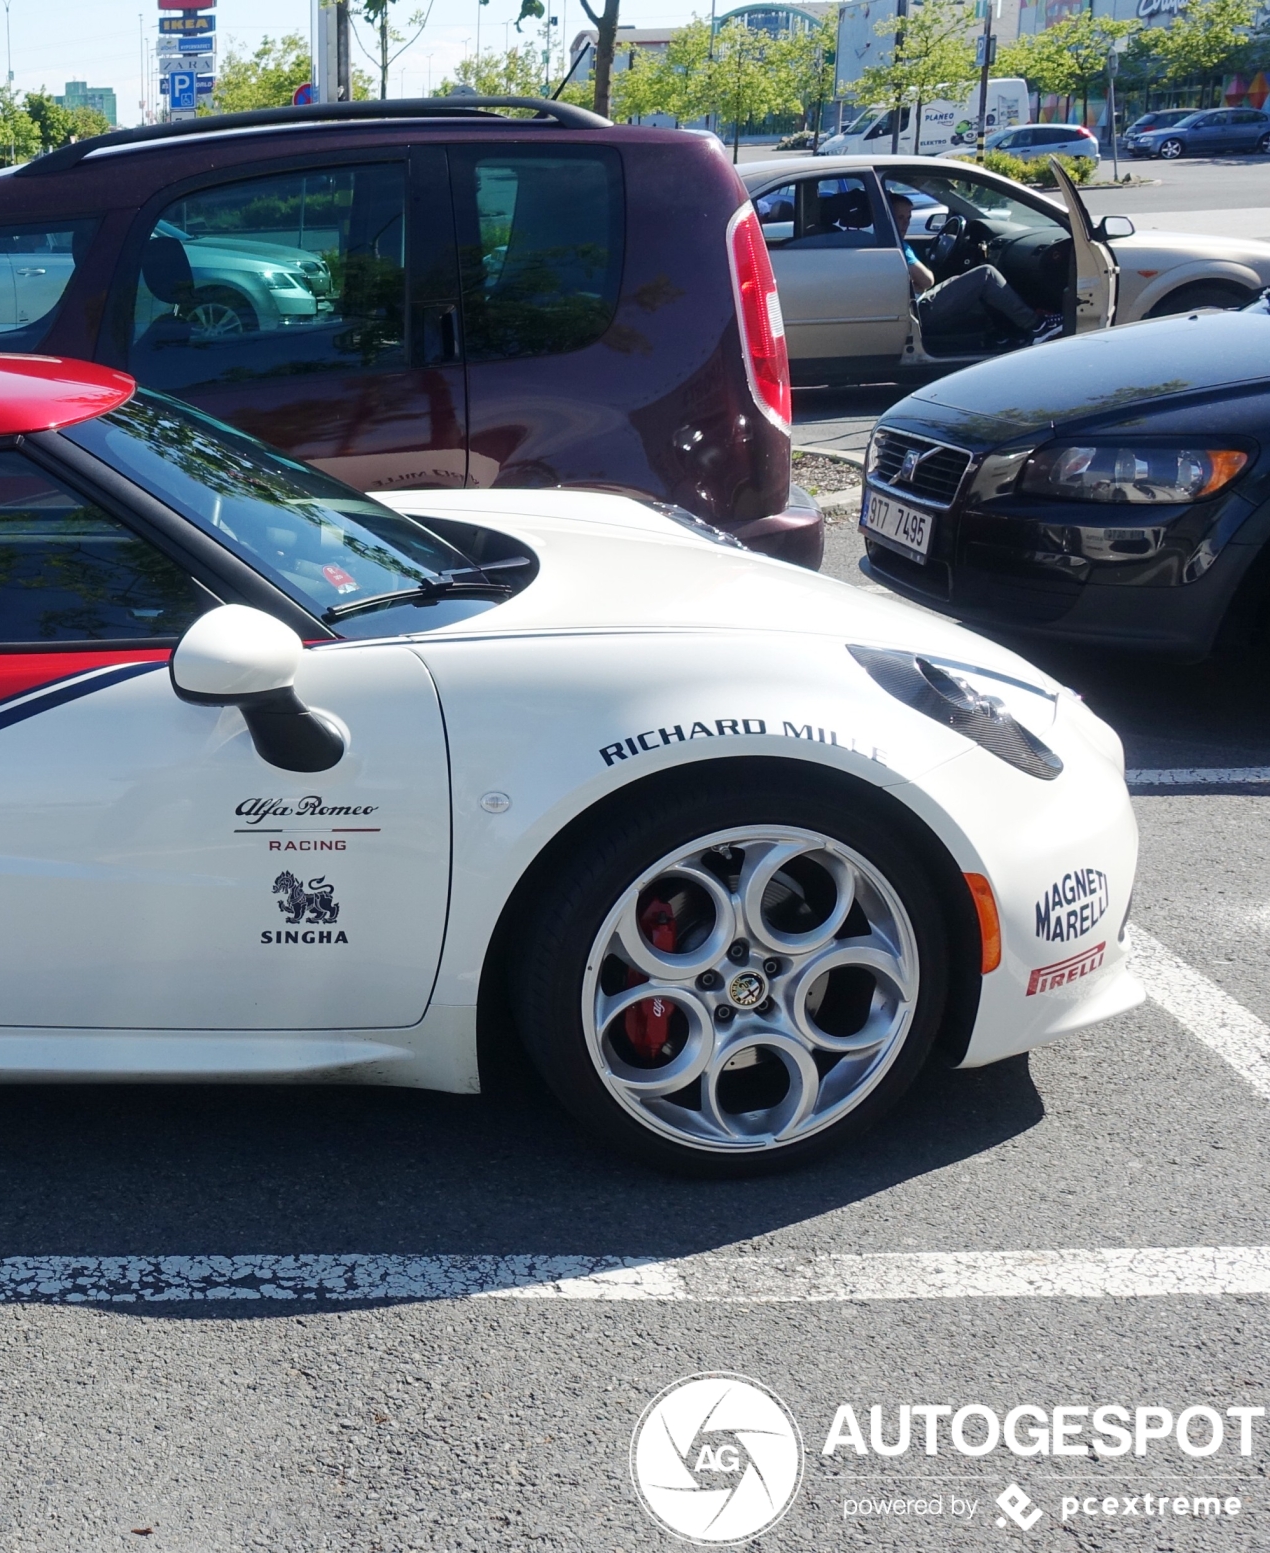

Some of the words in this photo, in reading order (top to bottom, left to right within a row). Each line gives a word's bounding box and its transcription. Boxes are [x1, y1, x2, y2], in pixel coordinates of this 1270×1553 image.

[163, 18, 208, 30] IKEA
[164, 60, 210, 70] ZARA
[174, 75, 190, 98] P
[925, 112, 954, 121] PLANEO
[869, 497, 890, 529] 9T7
[894, 508, 926, 546] 7495
[598, 718, 767, 767] RICHARD
[782, 721, 888, 768] MILLE
[235, 797, 293, 825] Alfa
[295, 795, 379, 816] Romeo
[269, 840, 347, 851] RACING
[1035, 868, 1109, 915] MAGNETI
[1035, 895, 1109, 942] MARELLI
[260, 930, 349, 944] SINGHA
[1025, 940, 1107, 997] PIRELLI
